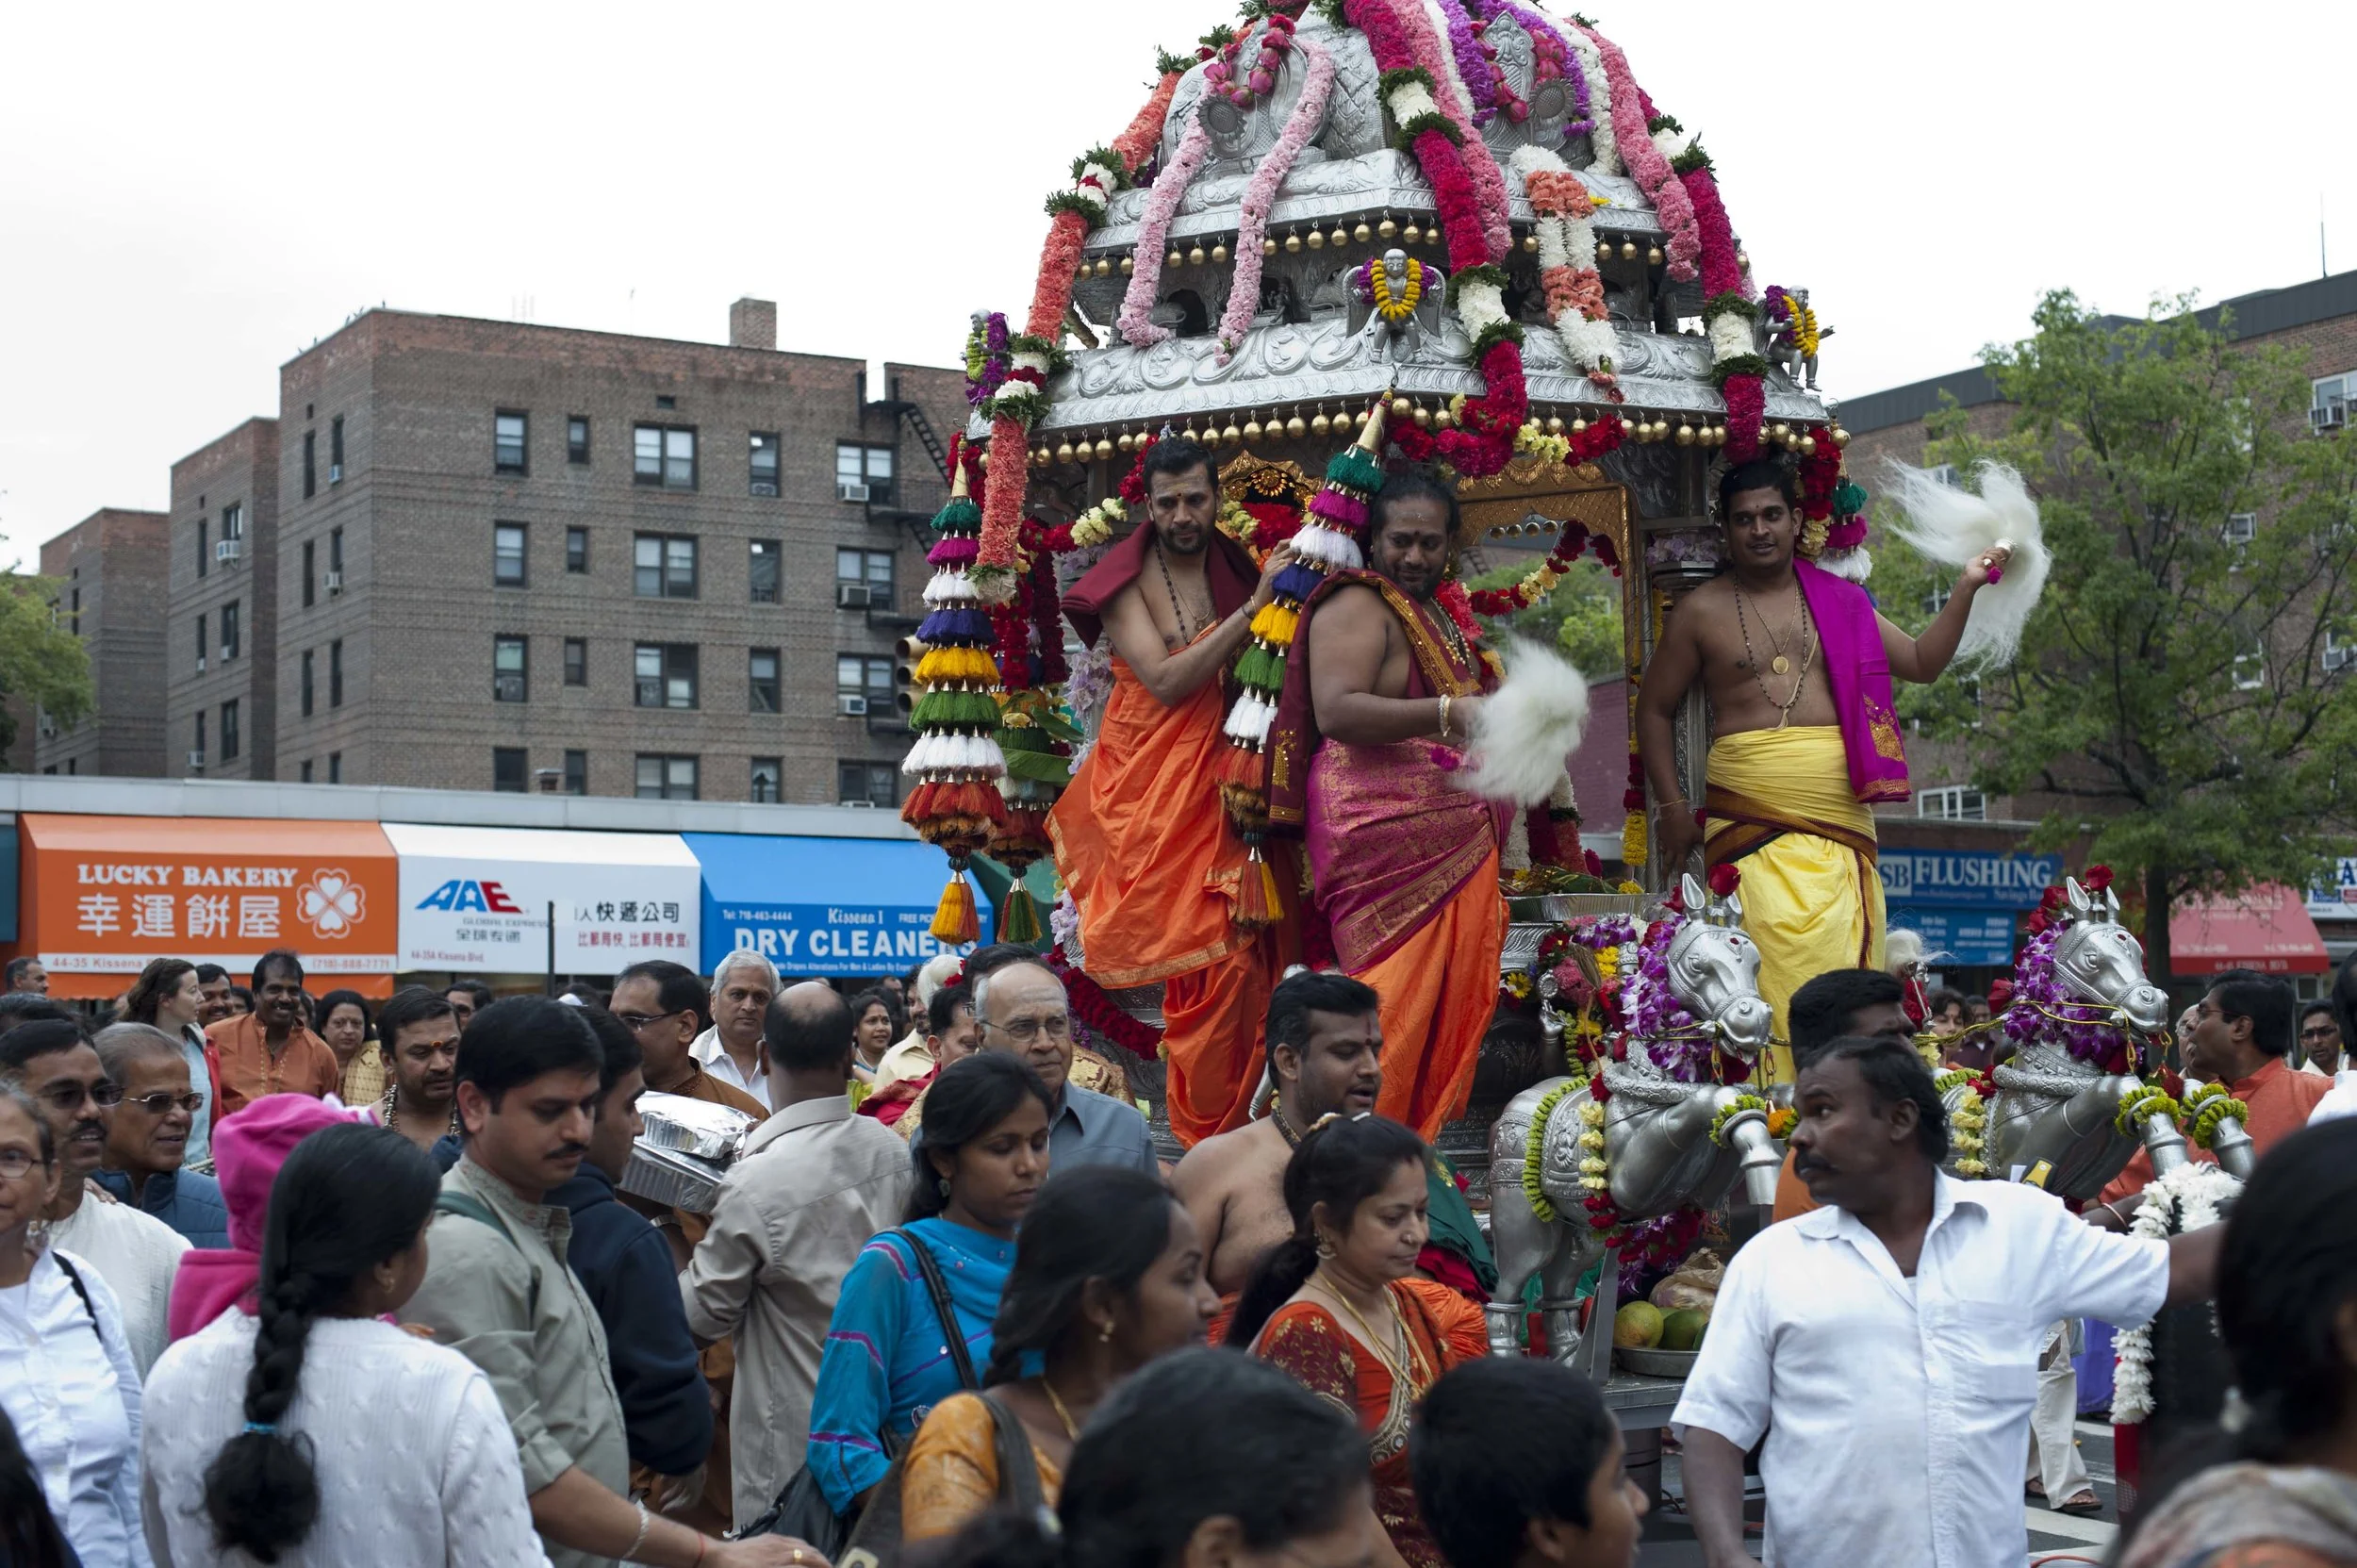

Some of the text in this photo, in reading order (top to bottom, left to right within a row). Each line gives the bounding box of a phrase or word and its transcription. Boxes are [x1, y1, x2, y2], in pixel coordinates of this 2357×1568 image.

[76, 864, 298, 888] LUCKY BAKERY
[1879, 863, 1909, 888] SB
[1913, 856, 2052, 889] FLUSHING
[415, 880, 523, 914] AAE
[76, 893, 281, 939] 幸運餅屋
[573, 900, 680, 924] 人快遞公司
[828, 907, 876, 925] Kissena
[898, 913, 918, 923] FREE
[734, 927, 799, 957] DRY
[53, 957, 88, 968] 44-35
[92, 957, 142, 968] Kissena
